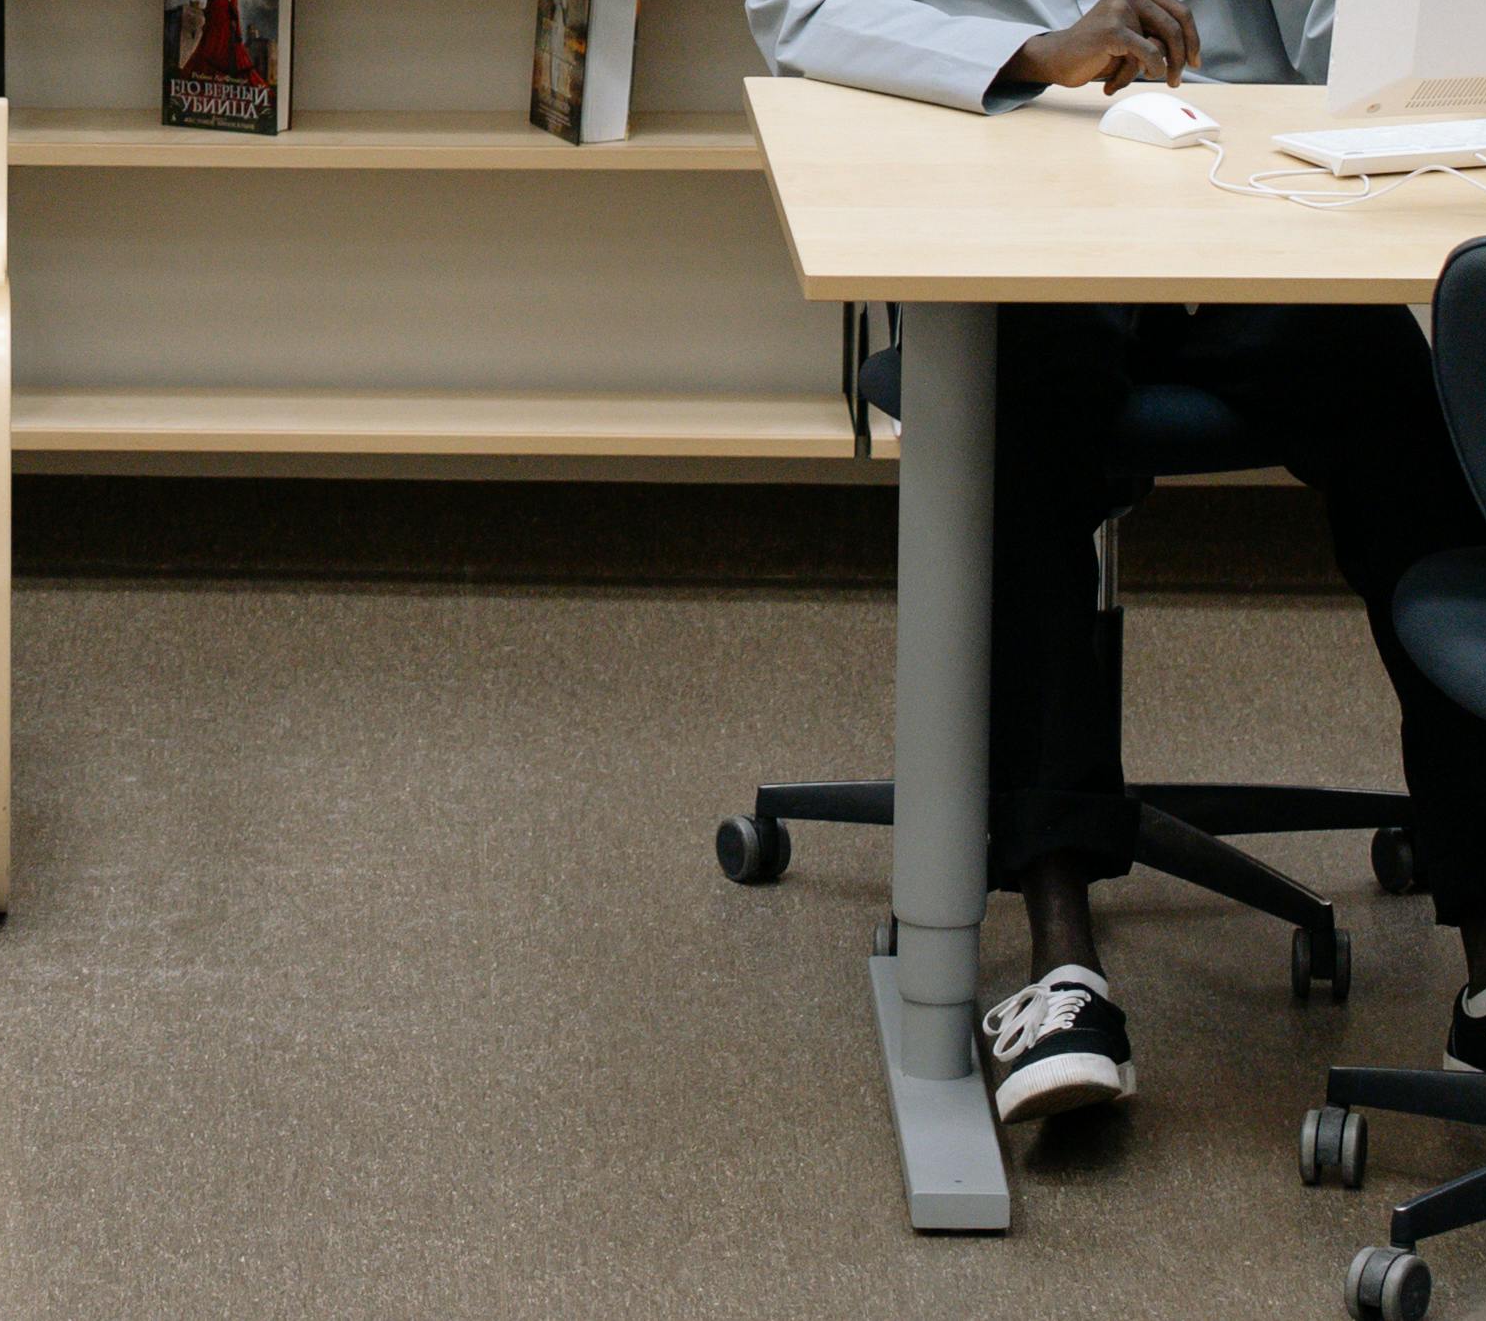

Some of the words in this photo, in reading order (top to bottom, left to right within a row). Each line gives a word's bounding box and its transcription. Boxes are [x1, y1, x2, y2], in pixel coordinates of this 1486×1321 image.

[170, 80, 202, 98] ЕГО
[205, 80, 270, 105] ВЕРНЫЙ
[180, 96, 259, 119] УБИЙЦА
